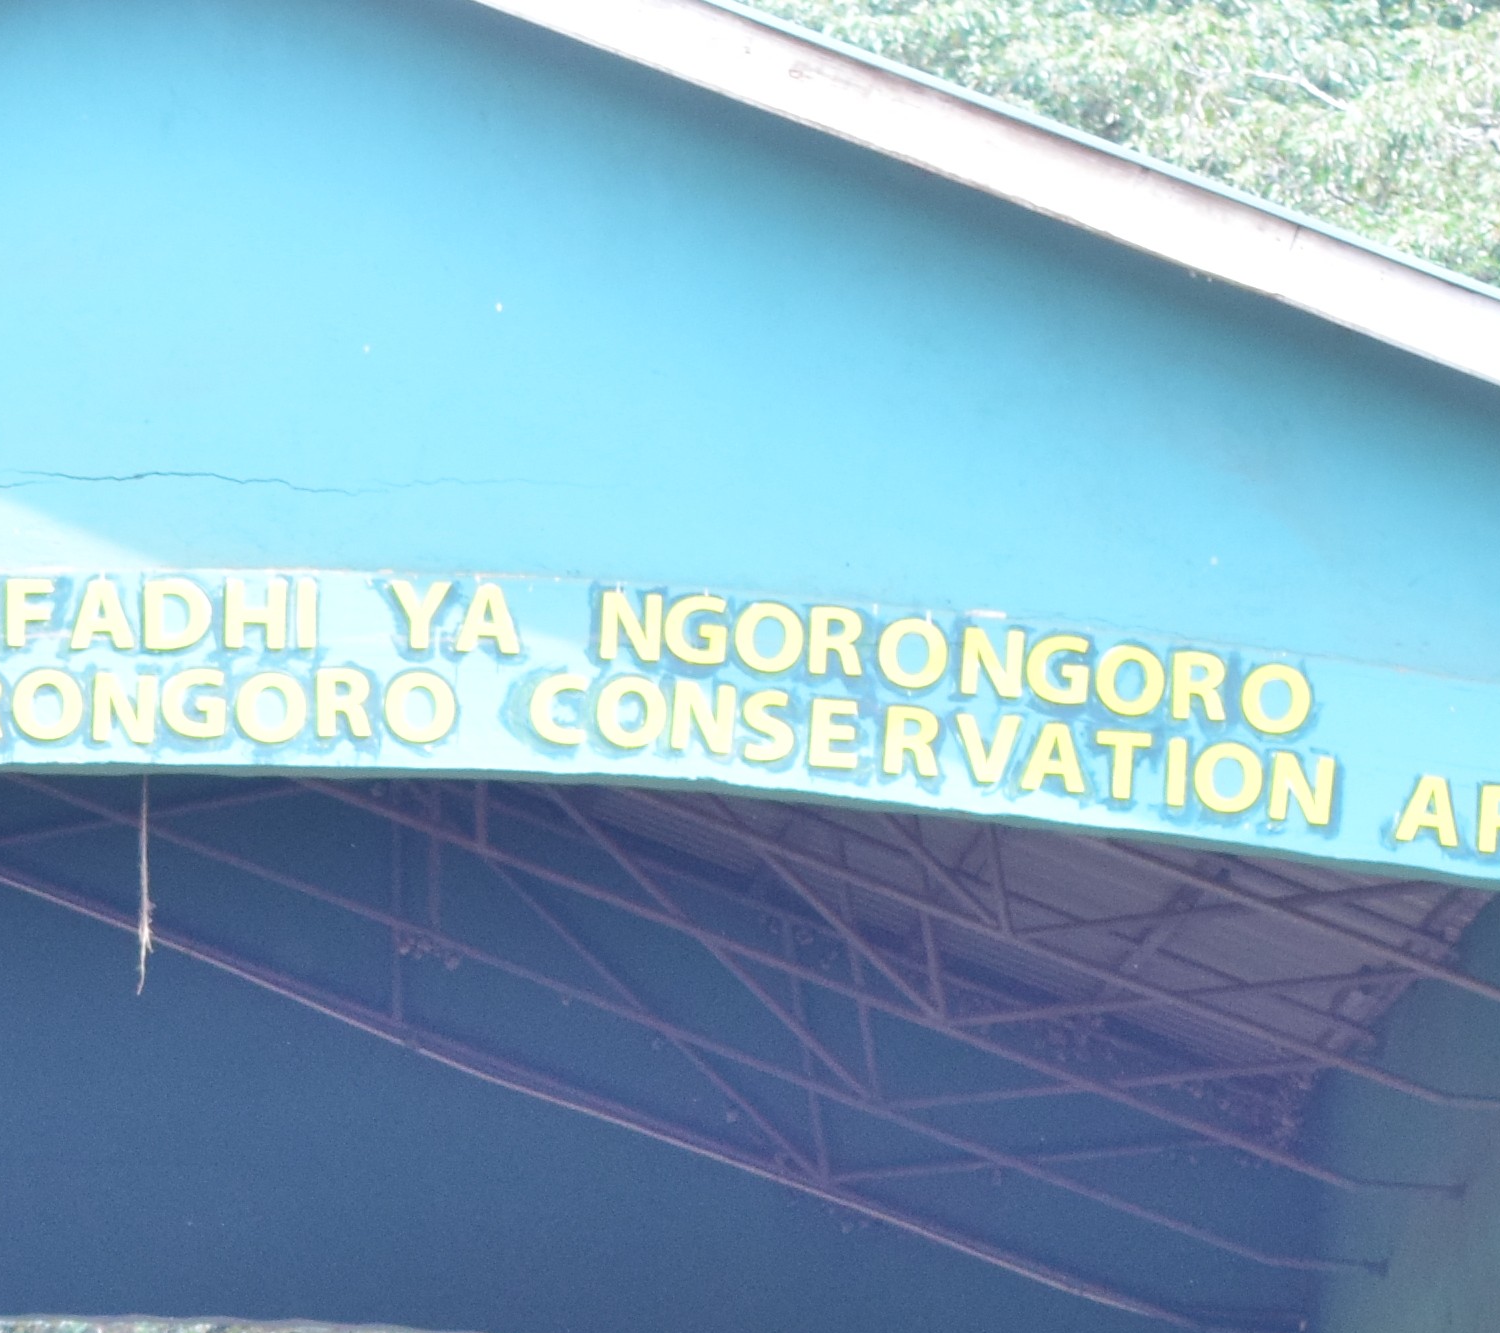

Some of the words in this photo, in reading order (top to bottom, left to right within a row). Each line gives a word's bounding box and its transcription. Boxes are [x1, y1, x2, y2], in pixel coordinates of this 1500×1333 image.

[393, 580, 521, 656] YA
[599, 589, 1313, 736] NGORONGORO
[530, 671, 1336, 826] CONSERVATION
